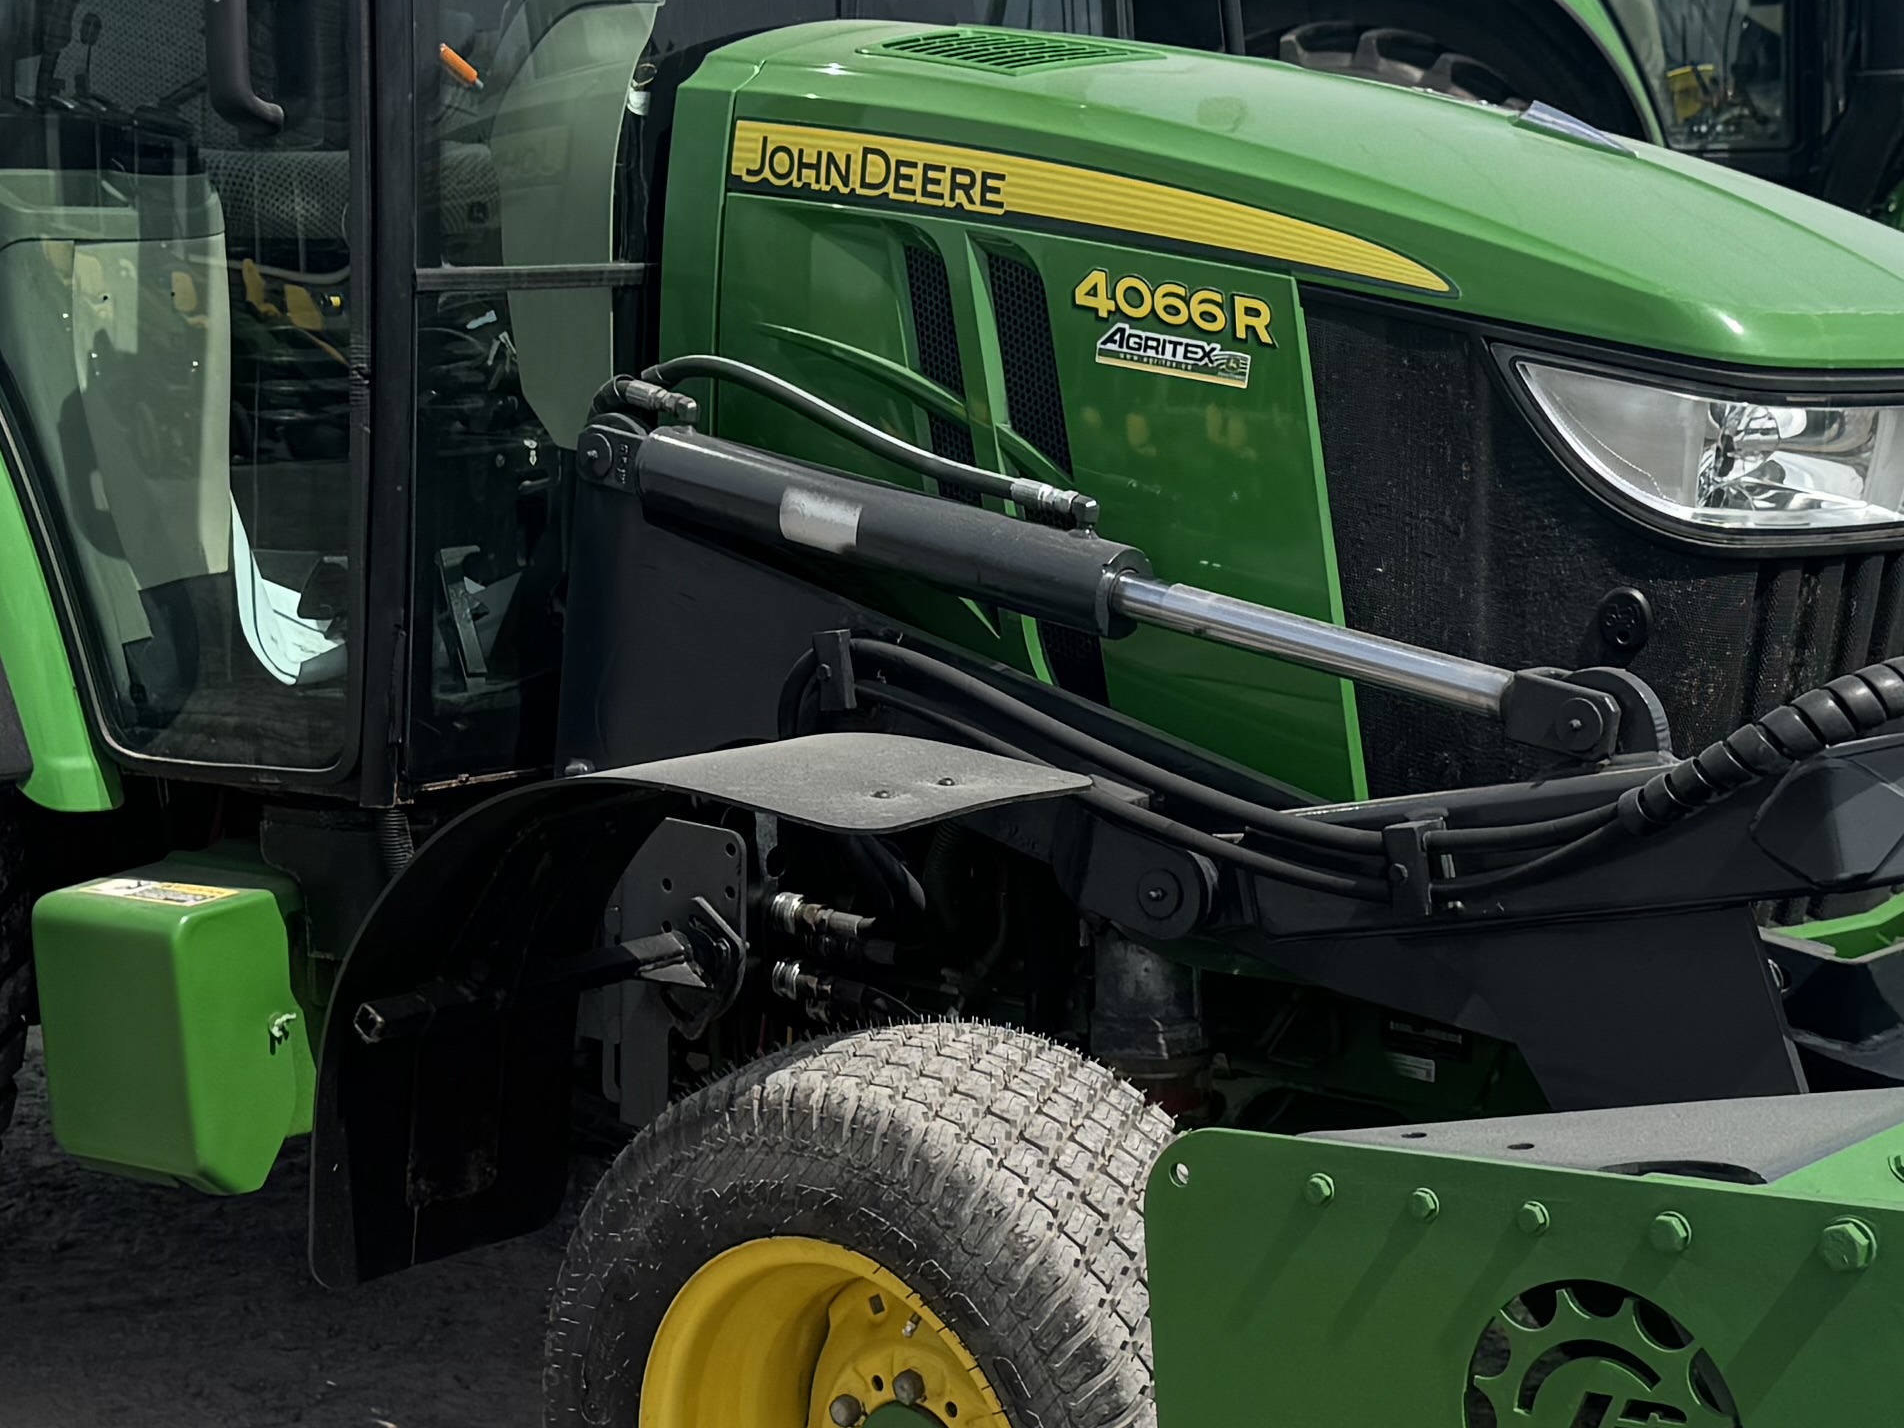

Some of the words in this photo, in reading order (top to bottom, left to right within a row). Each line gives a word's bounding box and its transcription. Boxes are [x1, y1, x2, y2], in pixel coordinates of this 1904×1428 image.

[746, 135, 852, 188] JOHN
[859, 146, 1006, 210] DEERE
[1074, 270, 1276, 345] 4066R
[1100, 327, 1217, 365] AGRITEX
